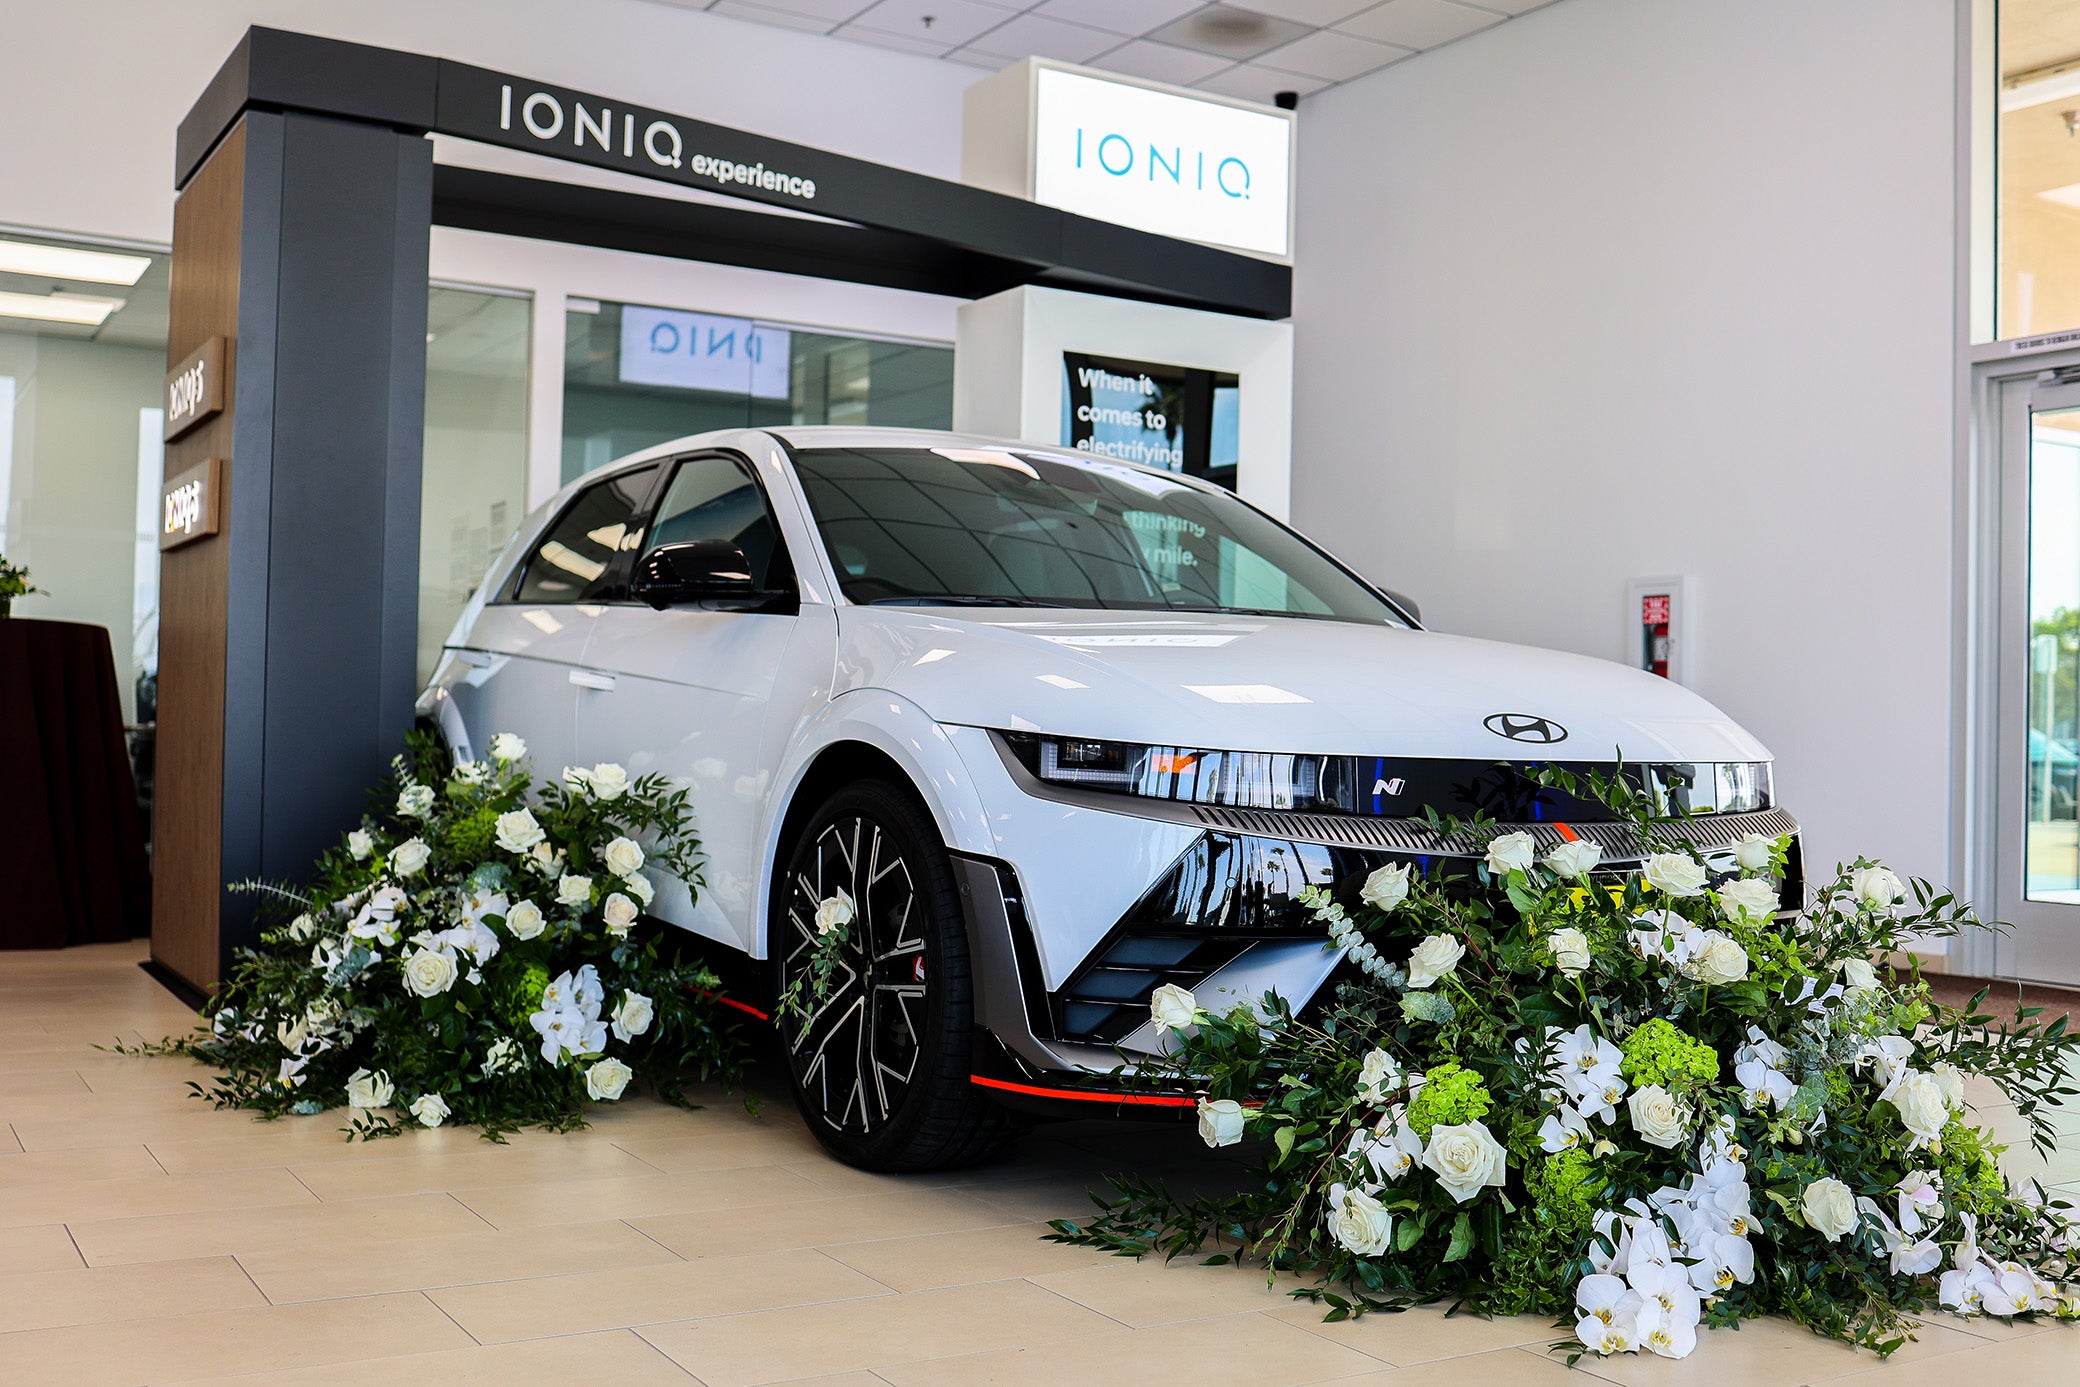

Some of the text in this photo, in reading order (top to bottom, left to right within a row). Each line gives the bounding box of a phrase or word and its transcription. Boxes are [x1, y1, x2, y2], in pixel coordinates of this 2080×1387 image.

[500, 84, 816, 199] IONIQ experience
[1076, 128, 1250, 200] IONIQ
[1077, 366, 1153, 396] When it
[1077, 405, 1167, 430] comes to
[1076, 437, 1183, 468] electrifying
[1153, 545, 1198, 567] mile.
